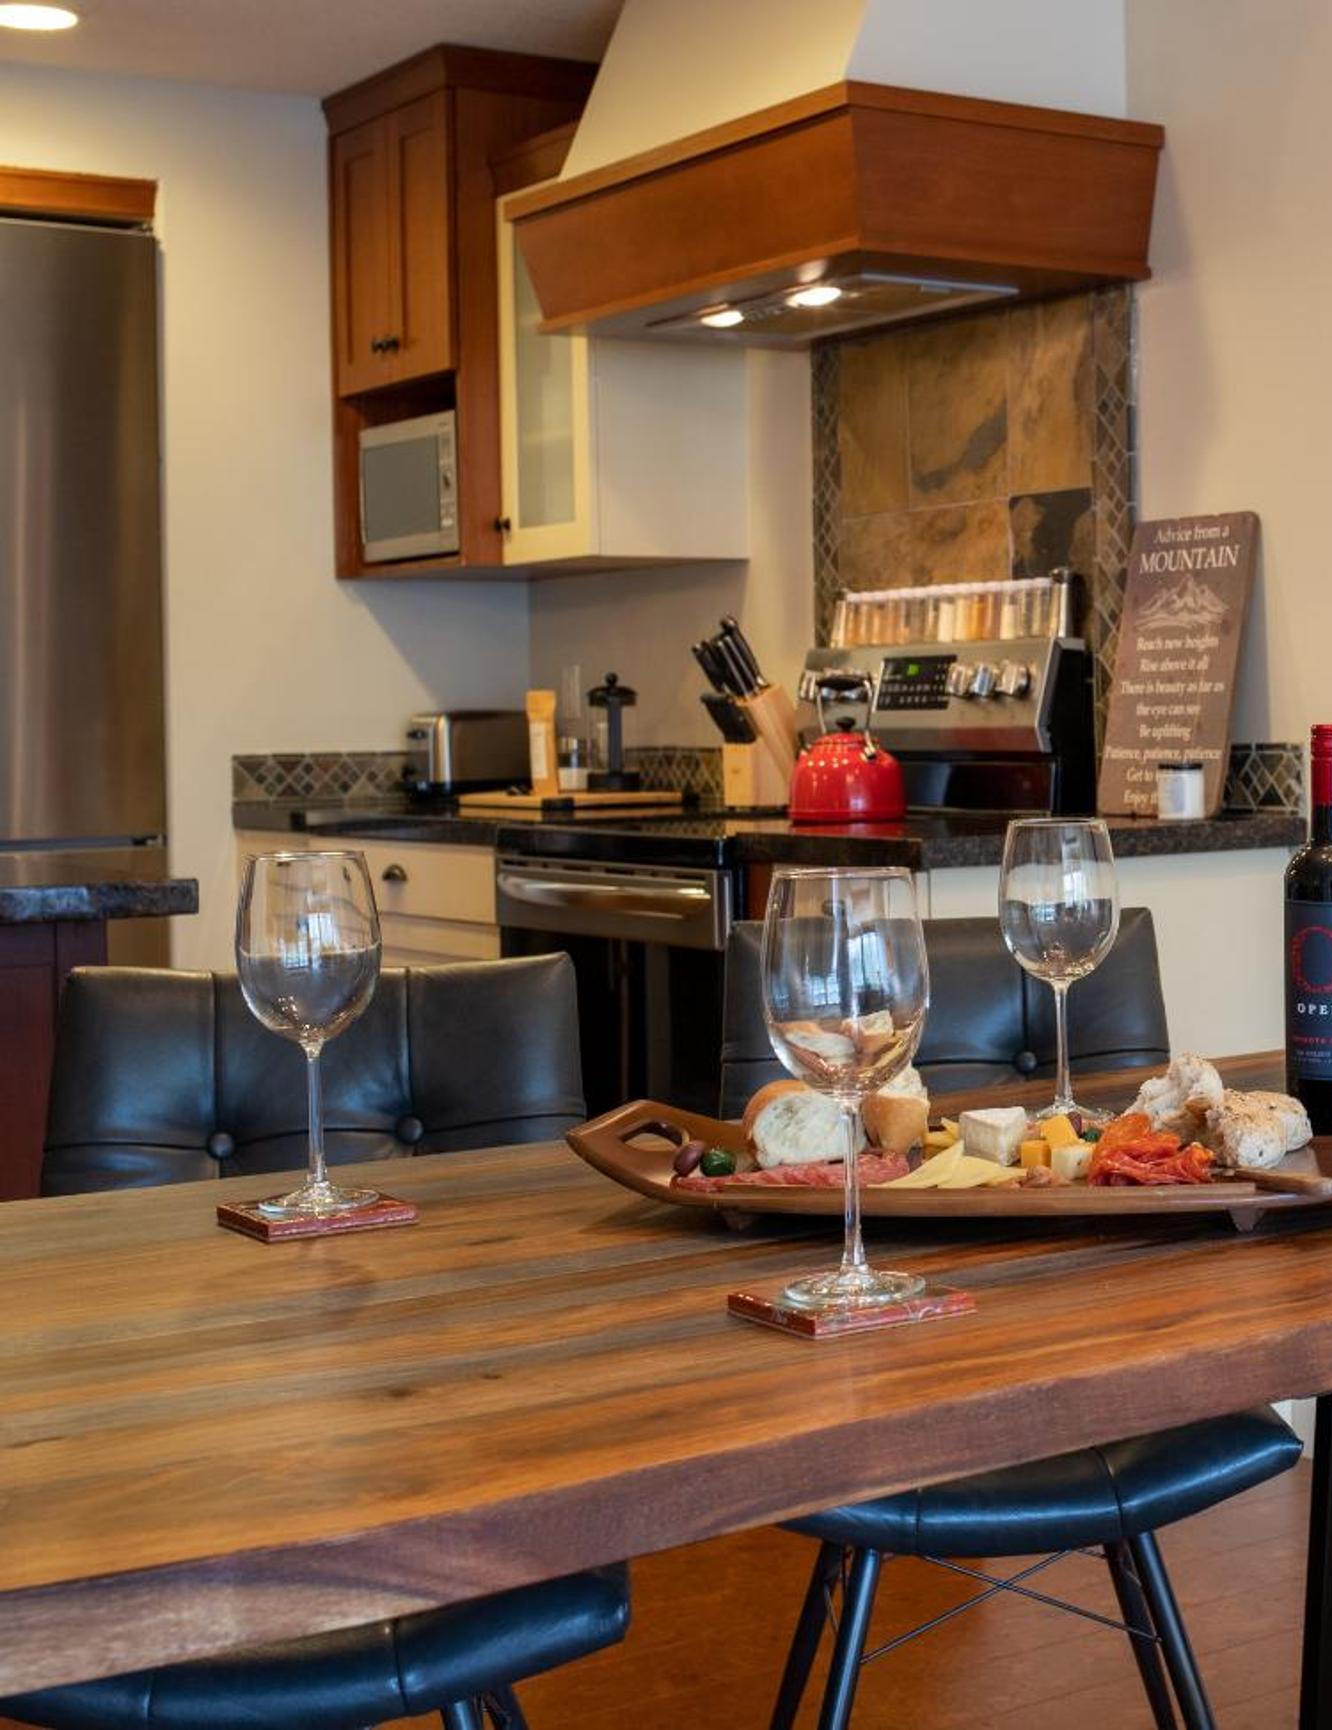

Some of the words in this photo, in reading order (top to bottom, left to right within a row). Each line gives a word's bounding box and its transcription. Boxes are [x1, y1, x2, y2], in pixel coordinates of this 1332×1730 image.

[1153, 528, 1192, 543] Advice
[1194, 527, 1221, 540] from
[1222, 526, 1230, 538] a
[1139, 545, 1240, 574] MOUNTAIN
[1136, 636, 1162, 652] Reach
[1164, 638, 1183, 650] new
[1184, 634, 1220, 653] heights
[1139, 658, 1158, 673] Rise
[1160, 657, 1186, 672] above
[1187, 658, 1196, 671] it
[1197, 654, 1209, 670] all
[1121, 681, 1144, 695] There
[1145, 681, 1153, 694] is
[1155, 680, 1185, 697] beauty
[1186, 682, 1197, 693] as
[1198, 680, 1212, 693] far
[1213, 681, 1225, 692] as
[1136, 703, 1151, 717] the
[1152, 705, 1167, 719] eye
[1168, 704, 1185, 716] can
[1186, 704, 1200, 715] see
[1139, 724, 1151, 738] Be
[1152, 723, 1193, 741] uplifting
[1127, 766, 1143, 783] Get
[1144, 768, 1155, 782] to
[1123, 789, 1150, 808] Enjoy
